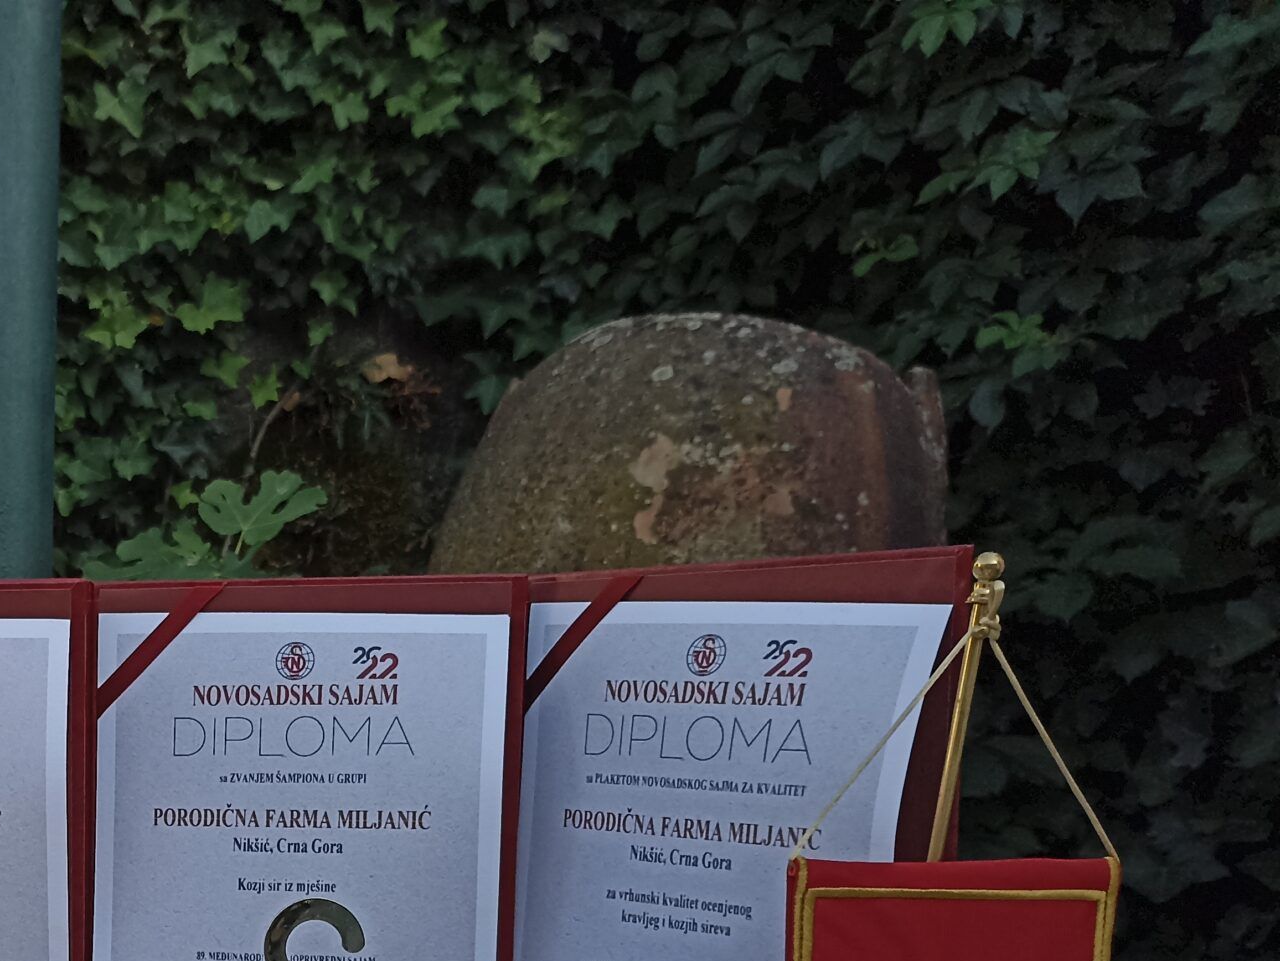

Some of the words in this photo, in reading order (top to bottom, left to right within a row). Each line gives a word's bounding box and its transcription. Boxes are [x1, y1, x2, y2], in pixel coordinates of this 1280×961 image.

[193, 684, 323, 706] NOVOSADSKI
[329, 684, 398, 705] SAJAM
[605, 680, 729, 704] NOVOSADSKI
[732, 681, 806, 706] SAJAM
[173, 716, 414, 757] DIPLOMA
[585, 713, 811, 765] DIPLOMA
[230, 773, 273, 783] ZVANJEM
[276, 771, 325, 783] ŠAMPIONA
[329, 774, 334, 783] U
[337, 773, 366, 783] GRUPI
[595, 773, 639, 785] PLAKETOM
[642, 776, 707, 790] NOVOSADSKOG
[709, 780, 738, 792] SAJMA
[741, 782, 753, 793] ZA
[757, 783, 806, 796] KVALITET
[154, 804, 259, 827] PORODIČNA
[266, 809, 331, 828] FARMA
[338, 805, 431, 829] MILJANIĆ
[564, 808, 655, 835] PORODIČNA
[661, 817, 722, 842] FARMA
[234, 838, 273, 853] Nikšić,
[277, 838, 307, 853] Crna
[312, 839, 343, 853] Gora
[630, 845, 666, 865] Nikšić,
[670, 849, 698, 867] Crna
[702, 852, 731, 870] Gora
[238, 878, 264, 894] Kozji
[268, 879, 281, 891] sir
[285, 879, 293, 891] iz
[297, 880, 336, 895] mješine
[606, 890, 616, 899] za
[619, 888, 659, 904] vrhunski
[663, 893, 698, 909] kvalitet
[701, 900, 752, 920] ocenjenog
[622, 910, 659, 930] kravljeg
[662, 914, 665, 927] i
[669, 915, 697, 934] kozjih
[701, 919, 730, 936] sireva
